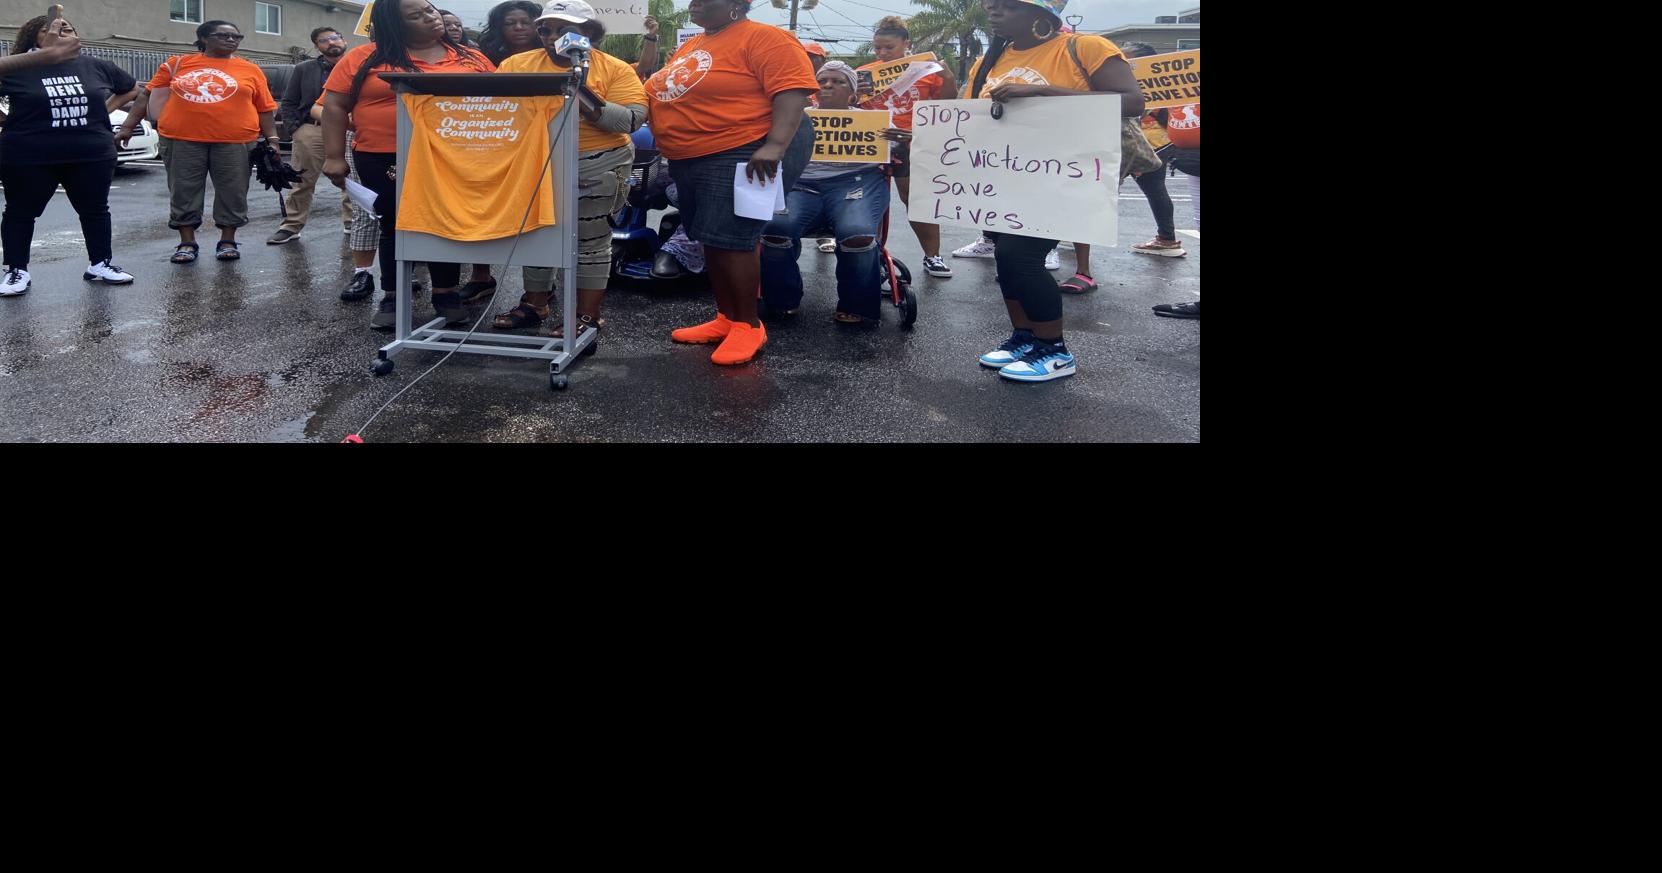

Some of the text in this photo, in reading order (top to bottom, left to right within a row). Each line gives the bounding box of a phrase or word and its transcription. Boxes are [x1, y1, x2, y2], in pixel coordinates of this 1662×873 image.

[878, 63, 910, 77] STOP
[1151, 58, 1194, 74] STOP
[41, 75, 80, 86] MIAMI
[1137, 72, 1200, 89] EVICTIO
[45, 83, 85, 97] RENT
[1142, 89, 1182, 102] SAVE
[50, 96, 88, 106] IS TOO
[435, 100, 519, 112] Community
[51, 105, 88, 119] DAMN
[52, 118, 88, 127] HIGH
[441, 117, 515, 130] Organized
[810, 116, 853, 128] STOP
[435, 128, 519, 142] Community
[815, 130, 876, 142] CTIONS
[828, 144, 878, 156] LIVES
[932, 174, 997, 196] Save
